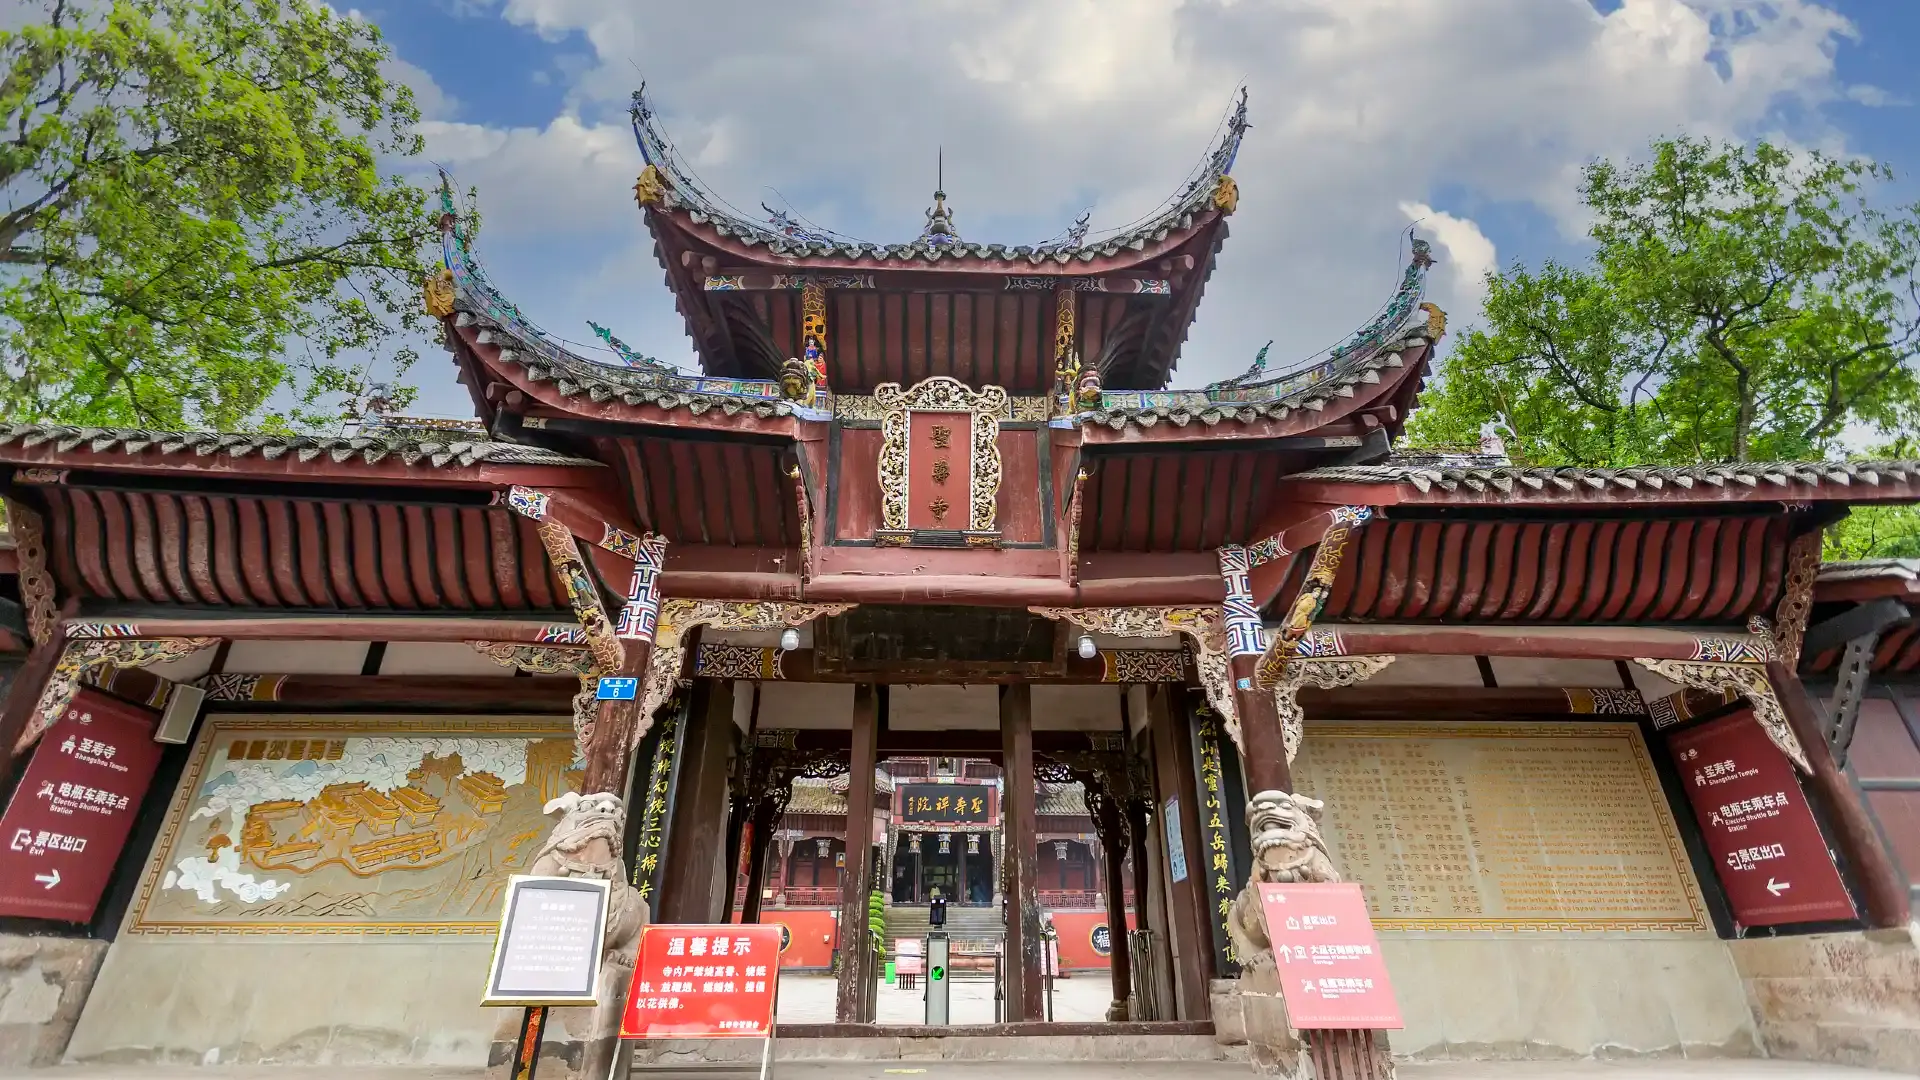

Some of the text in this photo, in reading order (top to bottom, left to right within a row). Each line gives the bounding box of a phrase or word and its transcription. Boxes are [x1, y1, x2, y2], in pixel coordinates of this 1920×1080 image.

[613, 687, 620, 698] 6
[78, 737, 117, 759] 圣寿寺
[75, 752, 129, 773] Shengshou Temple
[1704, 759, 1736, 779] 圣寿寺
[1709, 768, 1759, 786] Shengshou Temple
[58, 782, 129, 810] 电瓶车乘车点
[1720, 792, 1789, 818] 电瓶车乘车点
[50, 805, 73, 816] Station
[53, 797, 112, 815] Electric Shuttle Bus
[1725, 808, 1780, 826] Electric Shuttle Bus
[1727, 824, 1748, 833] Station
[34, 831, 87, 852] 景区出口
[29, 846, 45, 856] Exit
[1738, 843, 1786, 863] 景区出口
[1742, 863, 1756, 871] Exit
[667, 936, 752, 956] 温馨提示
[1094, 929, 1110, 948] 福
[636, 998, 684, 1009] 以花供佛。
